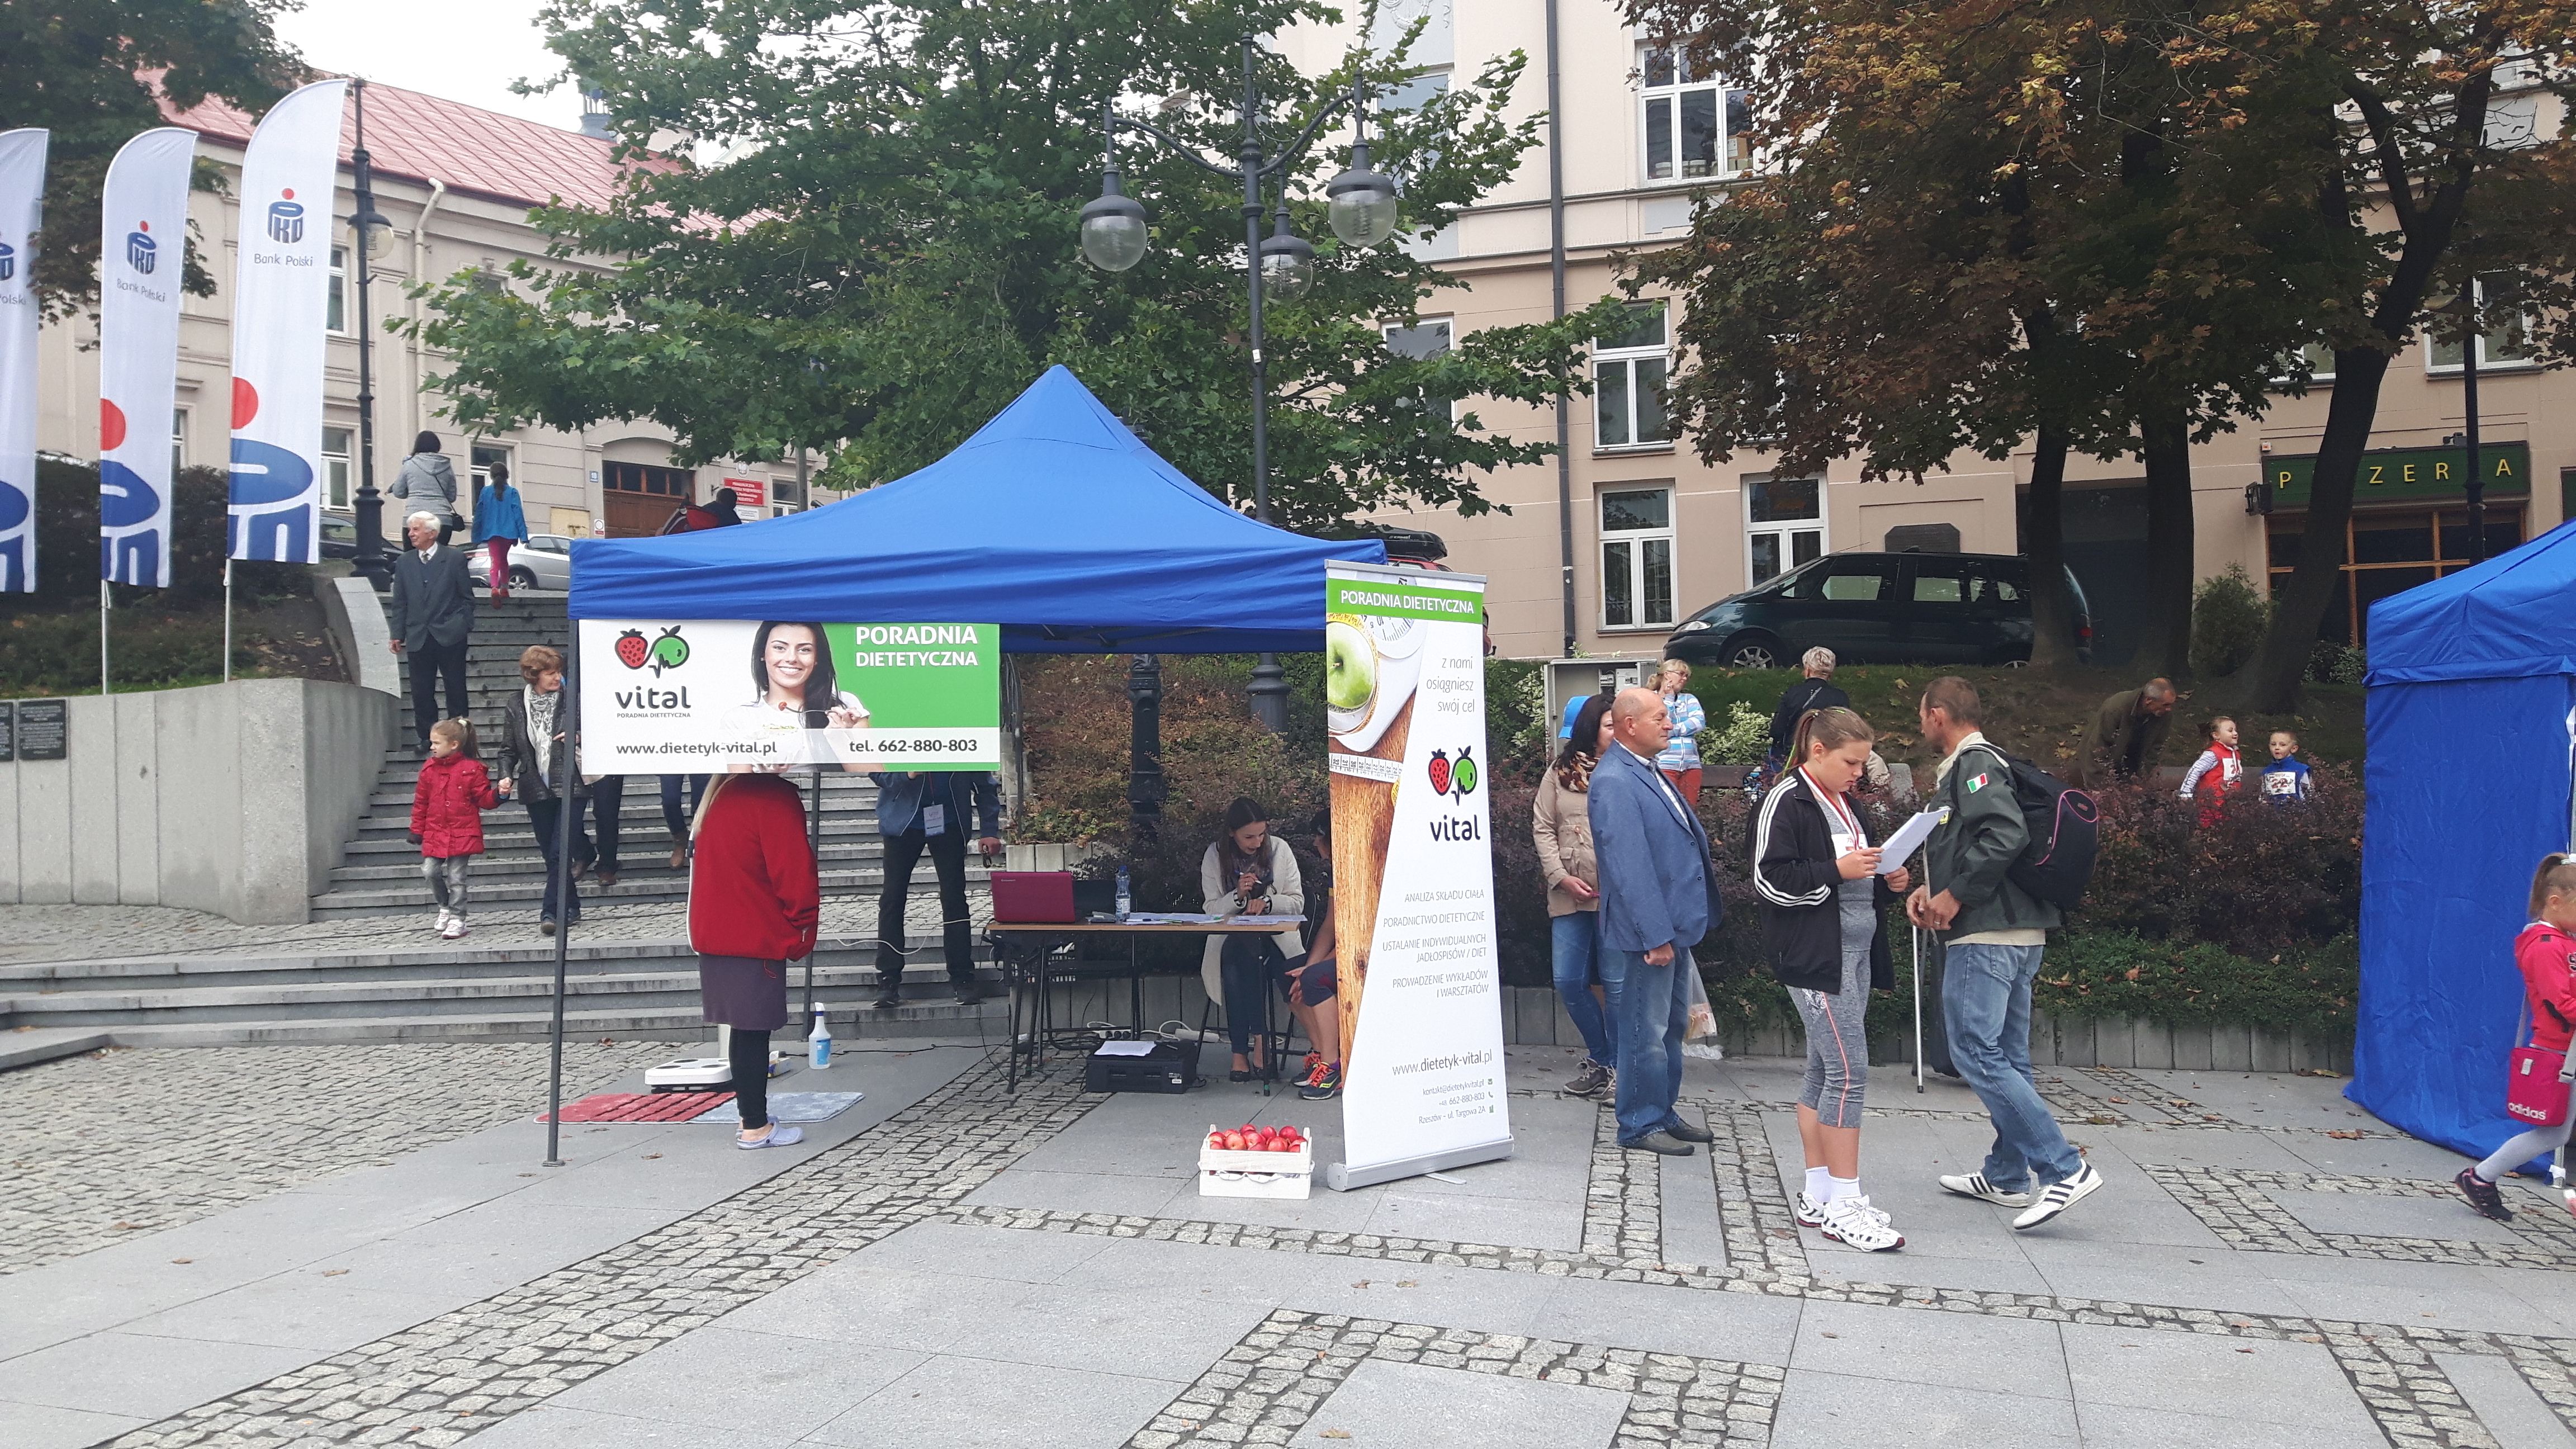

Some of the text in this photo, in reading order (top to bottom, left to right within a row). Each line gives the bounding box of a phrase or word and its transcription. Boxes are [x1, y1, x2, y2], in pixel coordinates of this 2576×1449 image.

[254, 253, 312, 267] Bank Polski
[117, 278, 165, 302] Bank Polski
[1341, 590, 1474, 614] PORADNIA DIETETYCZNA
[856, 626, 978, 645] PORADNIA
[856, 651, 978, 667] DIETETYCZNA
[1442, 656, 1472, 669] z nami
[1426, 676, 1474, 693] osiągniesz
[615, 685, 691, 709] vital
[1437, 698, 1475, 715] swój cel
[615, 739, 978, 756] www.dietetyk-vital.pl tel. 662-880-803
[1429, 814, 1481, 842] vital
[1405, 889, 1484, 903] ANALIZA SKŁADU CIAŁA
[1383, 911, 1485, 927] PORADNICTWO DIETETYCZNE
[1382, 933, 1486, 951] USTALANIE INDYWIDUALNYCH
[1416, 947, 1465, 963] JADŁOSPISÓW
[1471, 947, 1487, 958] DIET
[1393, 968, 1488, 988] PROWADZENIE WYKŁADÓW
[1440, 982, 1489, 997] WARSZTATÓW
[1392, 1048, 1492, 1076] www.dietetyk-vital.pl
[1449, 1092, 1485, 1105] 662-880-803
[1419, 1114, 1442, 1124] Rzeszów
[1455, 1108, 1477, 1119] Targowa
[1478, 1105, 1486, 1114] 2A
[2508, 1102, 2546, 1120] adidas
